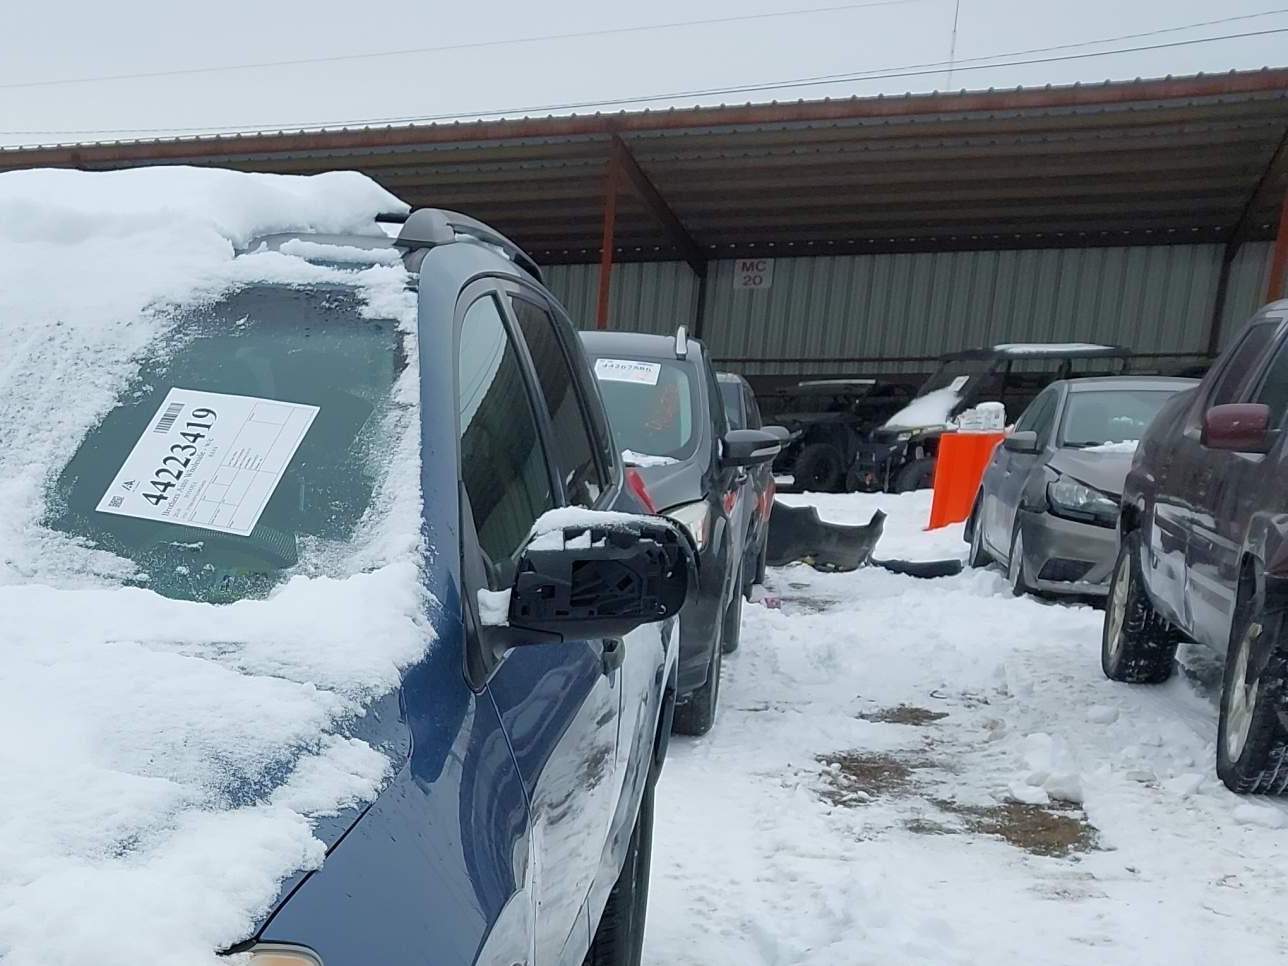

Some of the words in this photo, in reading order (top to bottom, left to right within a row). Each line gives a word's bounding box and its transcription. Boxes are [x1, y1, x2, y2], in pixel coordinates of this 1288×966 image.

[742, 261, 767, 272] MC
[743, 274, 763, 286] 20
[142, 408, 217, 506] 44223419
